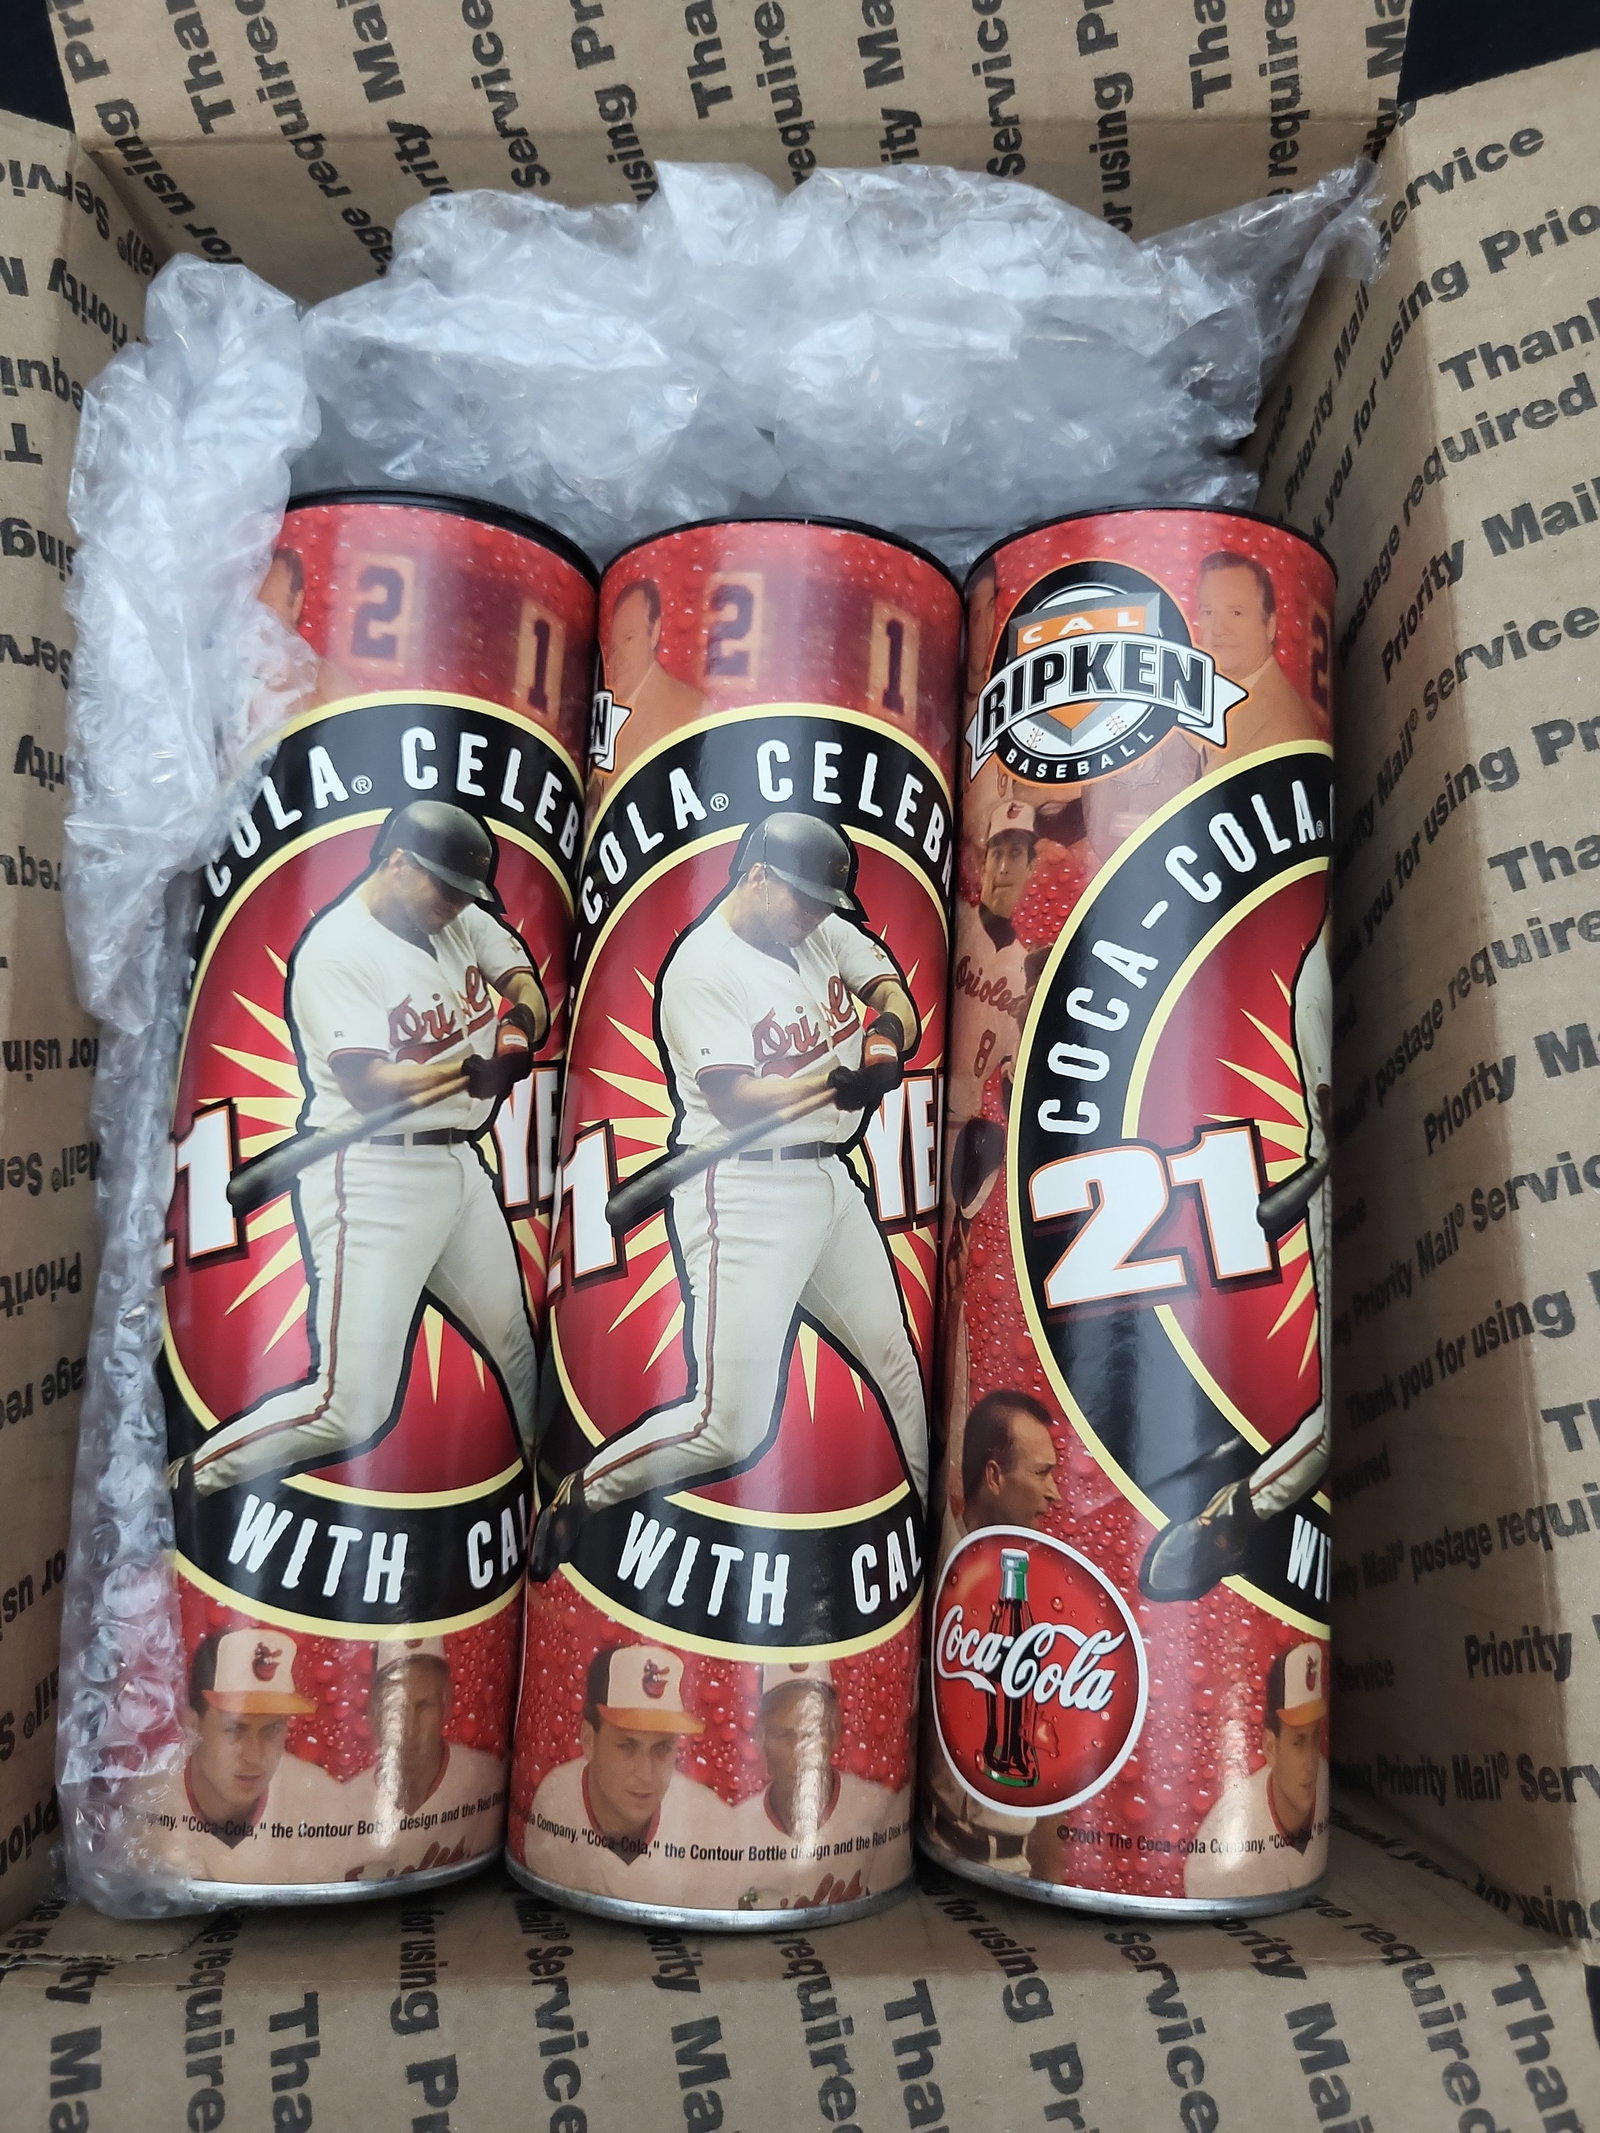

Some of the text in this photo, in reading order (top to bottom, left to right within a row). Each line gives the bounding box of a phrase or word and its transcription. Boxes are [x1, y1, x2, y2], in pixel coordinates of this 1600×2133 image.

[461, 0, 551, 189] Service
[1089, 71, 1134, 194] using
[95, 98, 196, 216] using
[1324, 443, 1353, 525] you
[1353, 377, 1378, 447] for
[1380, 260, 1470, 382] using
[1402, 371, 1598, 528] required
[1022, 611, 1141, 645] CAL
[1381, 539, 1465, 685] Priority
[1422, 606, 1600, 722] Service
[981, 640, 1207, 748] RIPKEN
[1005, 730, 1156, 779] BASEBALL
[1363, 879, 1394, 946] you
[1393, 831, 1421, 891] for
[1423, 746, 1520, 845] using
[972, 1028, 997, 1080] 8
[1375, 998, 1444, 1107] postage
[1423, 1055, 1517, 1156] Priority
[1028, 1122, 1275, 1310] 21
[1399, 1356, 1434, 1411] you
[1436, 1337, 1466, 1380] for
[1471, 1290, 1576, 1359] using
[227, 1493, 410, 1604] WITH
[616, 1510, 923, 1627] WITH CAL
[1410, 1522, 1493, 1584] postage
[937, 1604, 1127, 1713] Coca-Cola
[1464, 1624, 1573, 1682] Priority
[271, 1822, 293, 1838] the
[298, 1820, 354, 1838] Contour
[400, 1812, 438, 1830] design
[441, 1806, 460, 1823] and
[461, 1803, 476, 1818] the
[1376, 1754, 1447, 1806] Priority
[537, 1815, 579, 1844] Company.
[664, 1842, 686, 1859] the
[690, 1844, 744, 1862] Contour
[749, 1845, 786, 1862] Bottle
[833, 1837, 853, 1855] and
[856, 1835, 870, 1850] the
[872, 1827, 887, 1847] Red
[1106, 1831, 1132, 1850] The
[1136, 1834, 1206, 1855] Coca-Cola
[390, 1938, 448, 2036] using
[967, 1925, 1055, 2025] using
[524, 1944, 590, 2133] Service
[1103, 1930, 1220, 2133] Service
